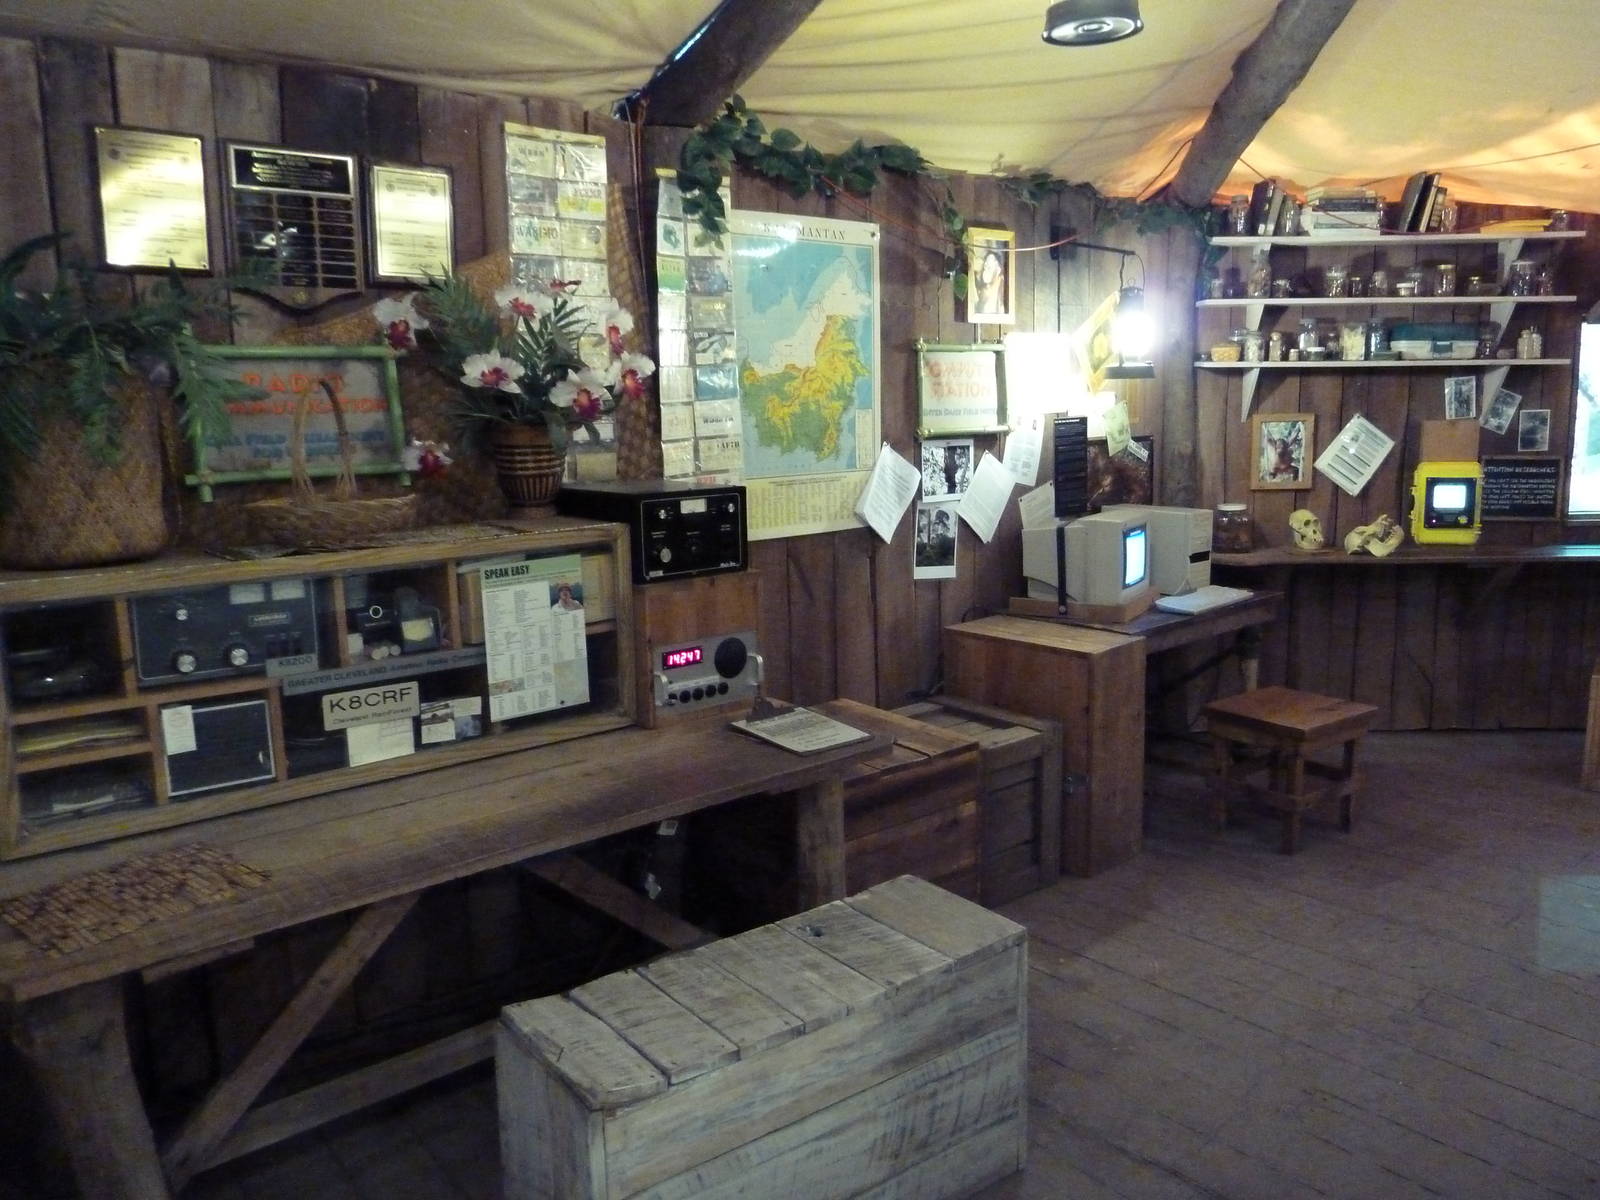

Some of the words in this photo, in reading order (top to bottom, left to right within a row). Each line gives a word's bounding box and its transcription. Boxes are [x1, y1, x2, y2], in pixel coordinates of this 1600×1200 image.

[763, 223, 846, 240] KMANTAN
[484, 567, 509, 580] SPEAK
[511, 565, 530, 577] EASY
[287, 674, 332, 688] GREATER
[334, 666, 387, 681] CLEVELAND
[329, 686, 413, 713] K8CRF
